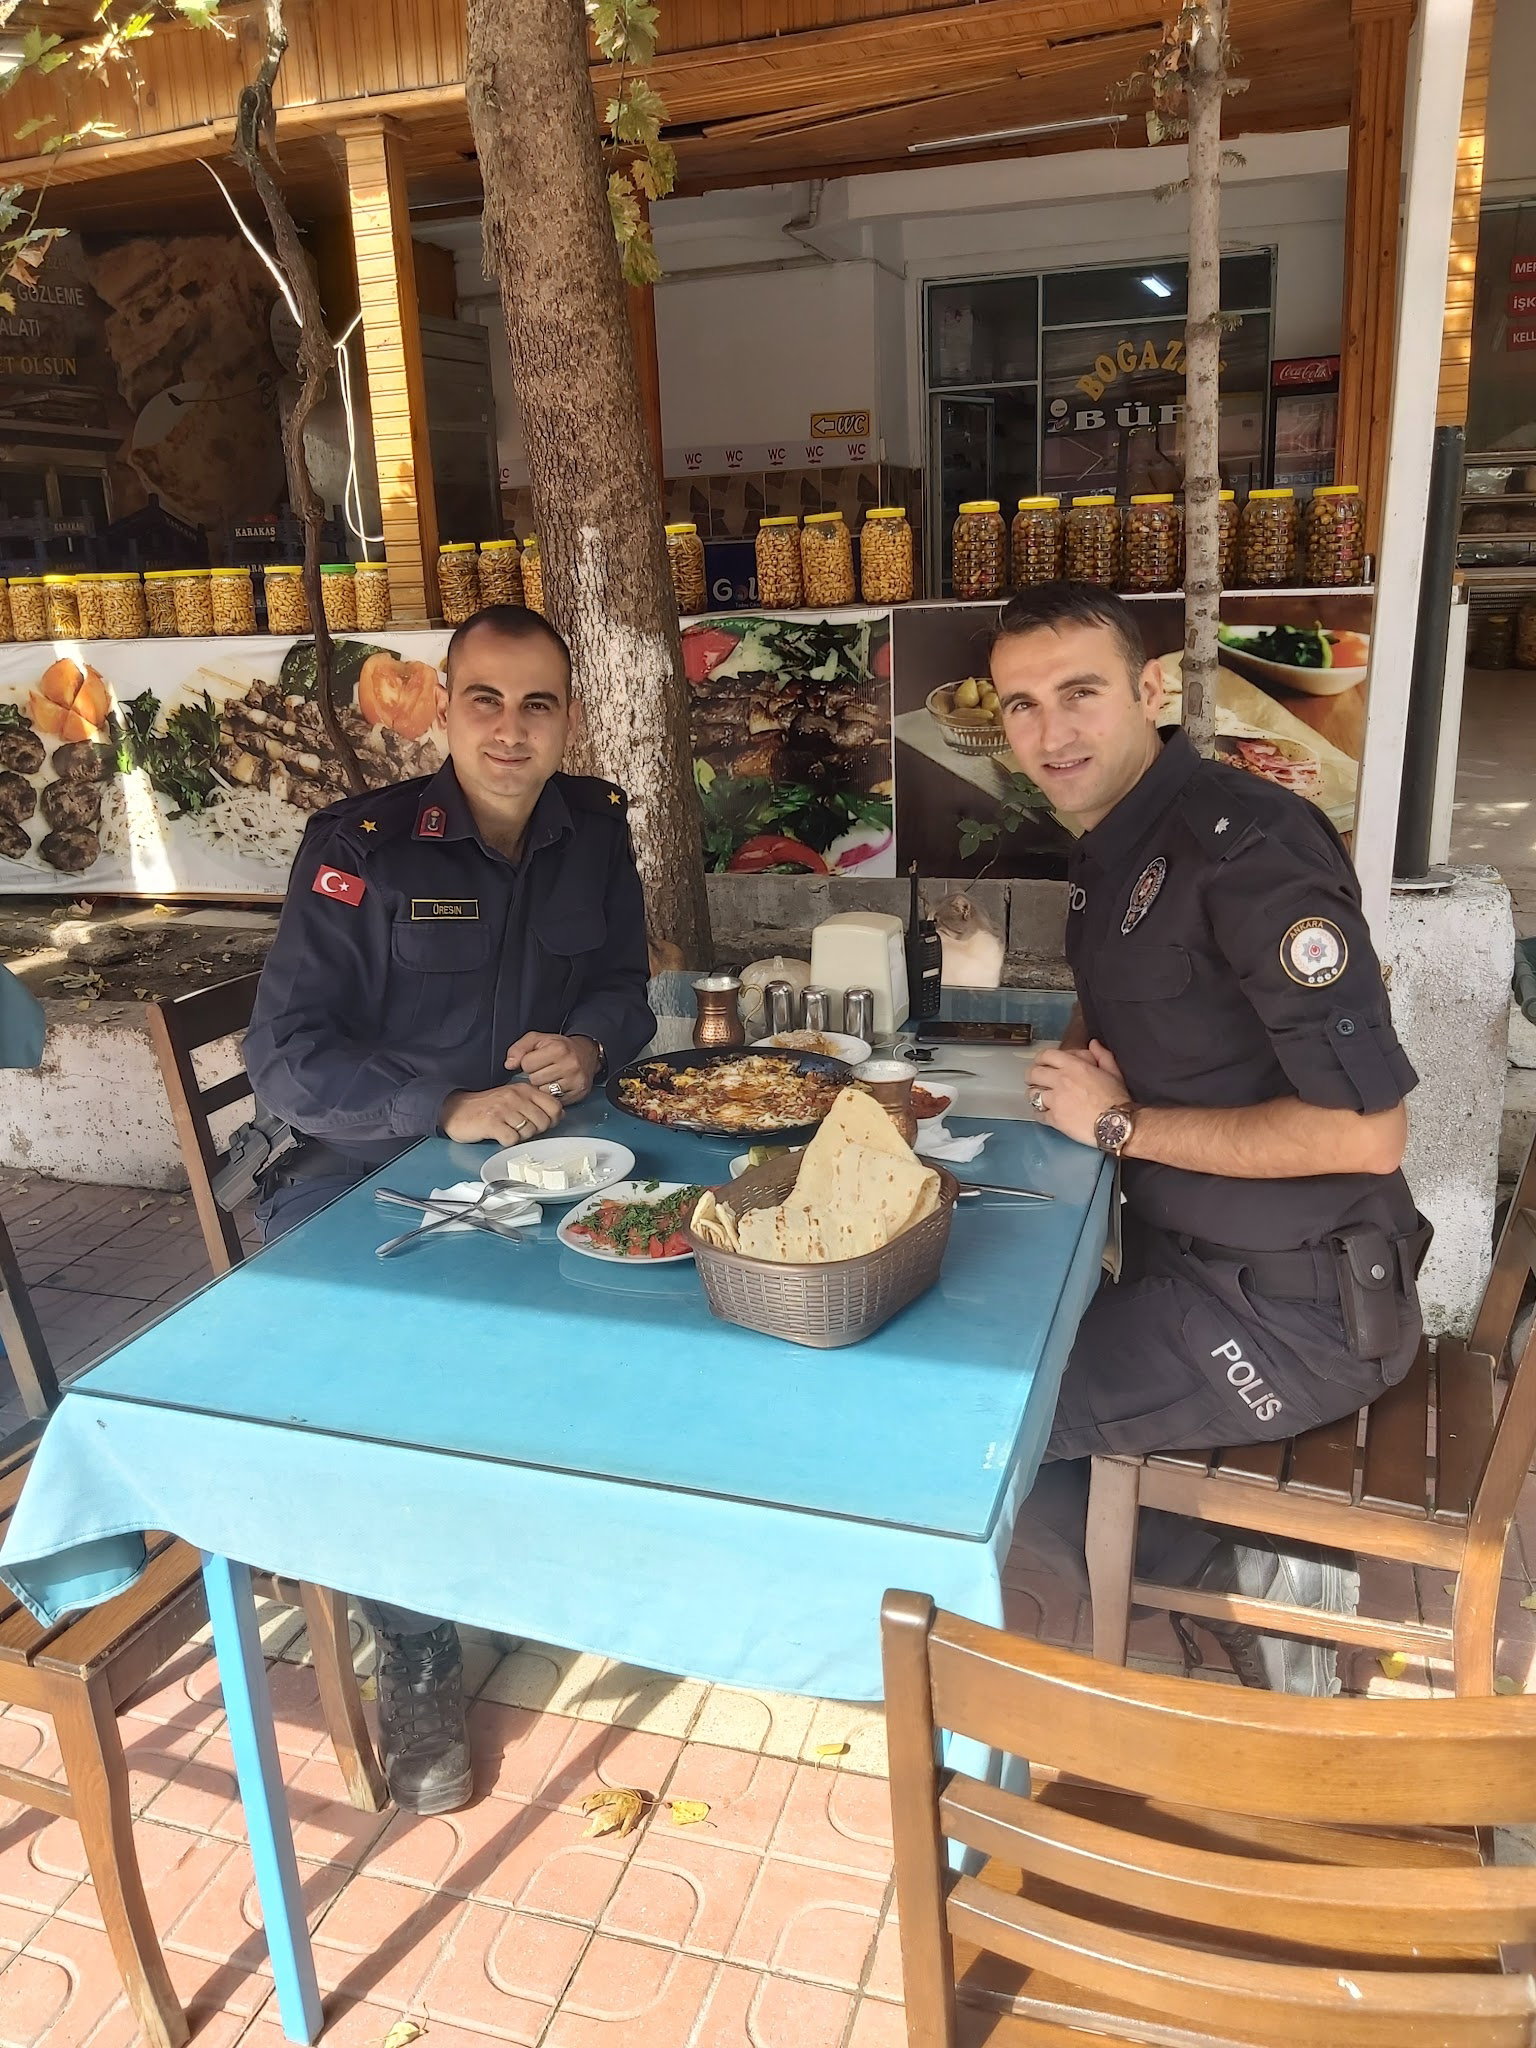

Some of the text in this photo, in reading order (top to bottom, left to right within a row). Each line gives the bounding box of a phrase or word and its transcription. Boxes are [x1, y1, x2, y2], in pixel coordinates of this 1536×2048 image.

[20, 356, 77, 376] OLSUN
[836, 414, 866, 435] WC
[1074, 401, 1223, 431] BÜF
[685, 443, 866, 464] WC WC WC WC WC
[234, 526, 277, 538] KARAKAS
[1289, 920, 1324, 940] ANKARA
